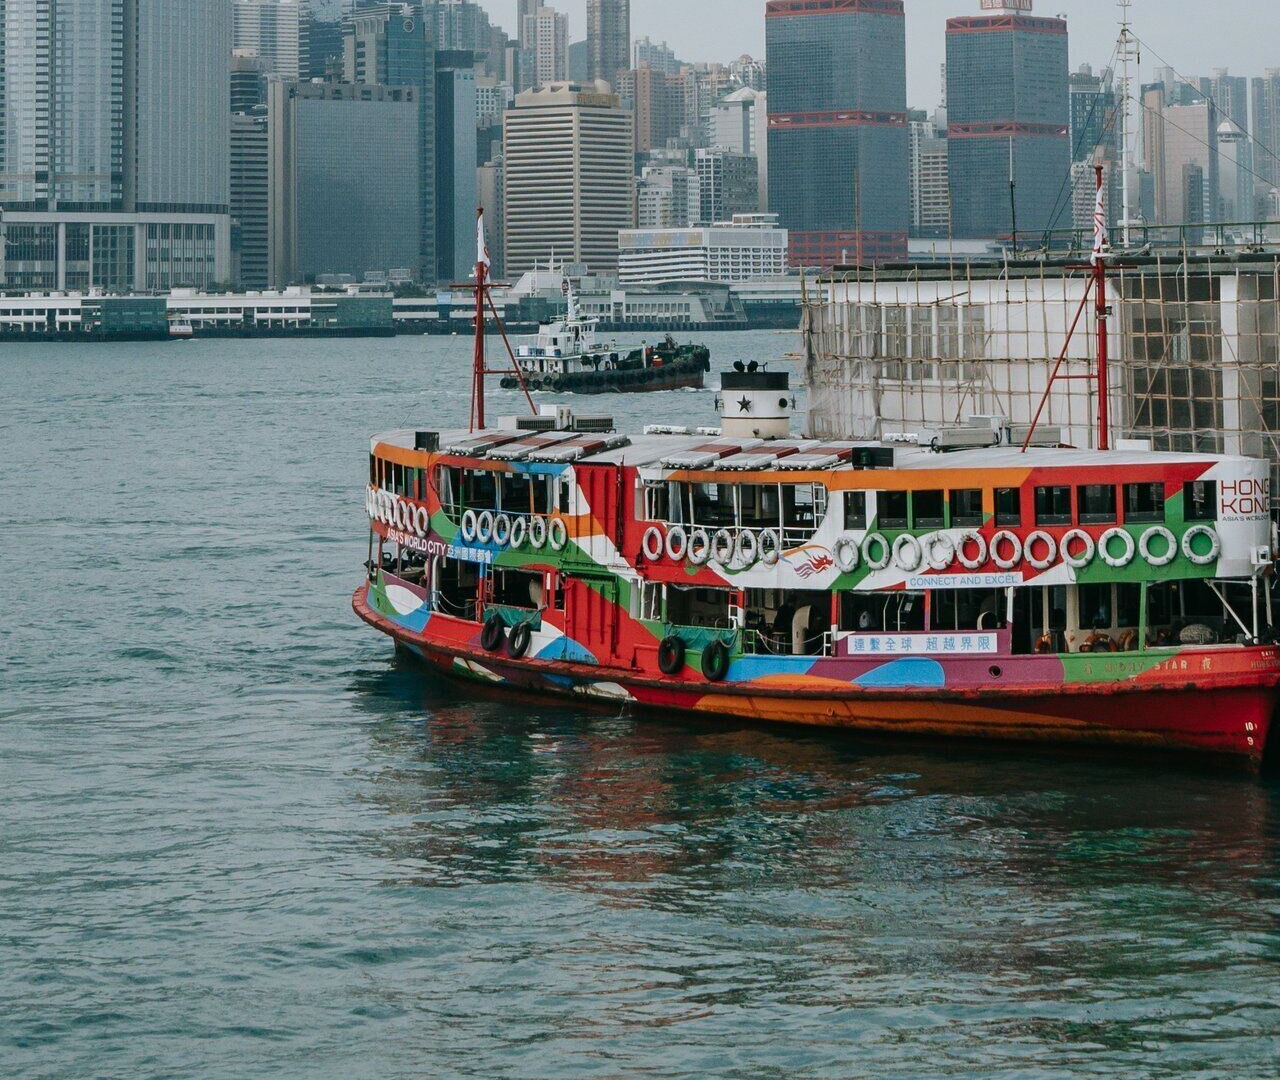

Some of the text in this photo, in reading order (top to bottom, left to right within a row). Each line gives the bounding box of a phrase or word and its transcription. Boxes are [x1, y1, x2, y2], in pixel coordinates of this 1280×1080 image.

[1221, 478, 1270, 496] HONG
[1221, 497, 1270, 514] KONG
[387, 527, 447, 556] ASIA'S WORLD CITY
[910, 574, 1018, 587] CONNECT AND EXCEL
[1154, 659, 1188, 671] STAR
[1245, 721, 1254, 732] 10
[1247, 736, 1254, 746] 9
